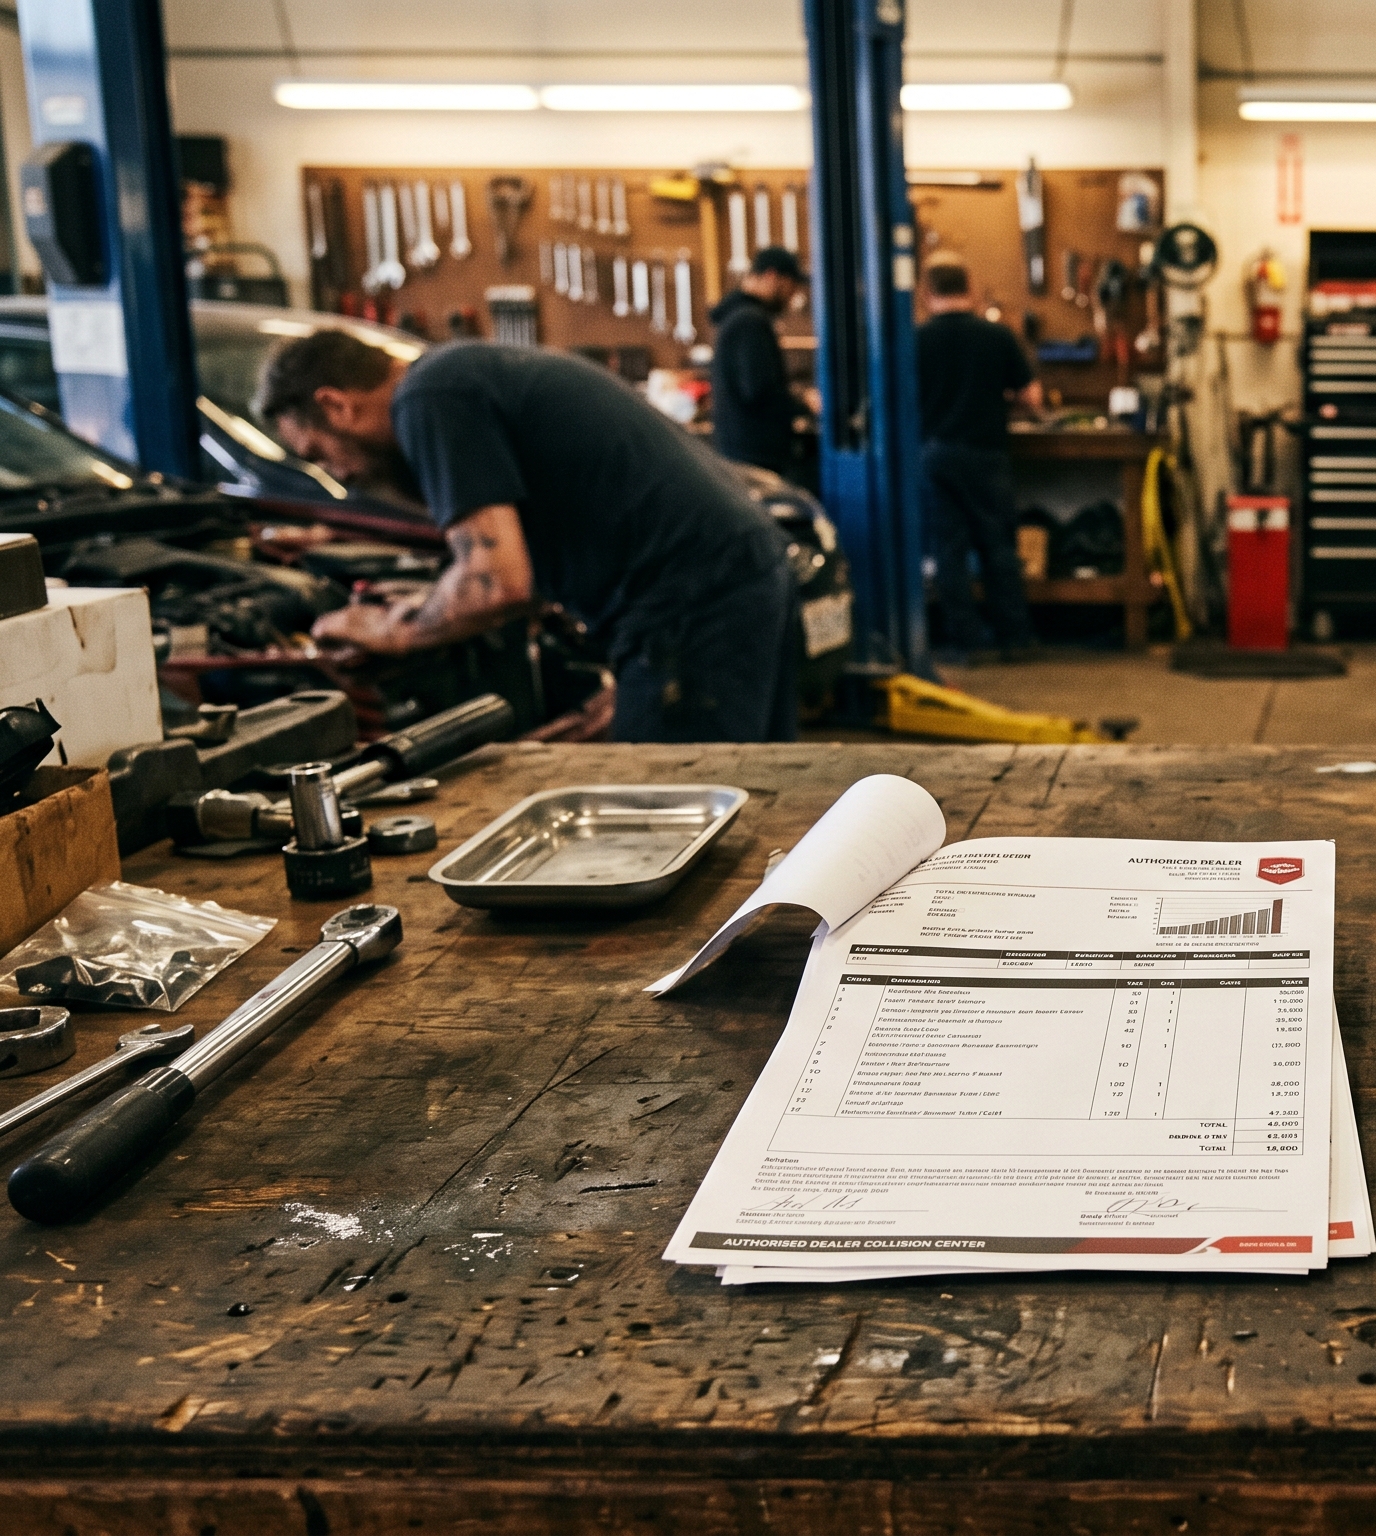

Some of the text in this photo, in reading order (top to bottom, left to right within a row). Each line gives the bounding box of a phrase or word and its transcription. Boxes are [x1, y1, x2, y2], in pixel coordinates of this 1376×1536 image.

[723, 1238, 985, 1248] AUTHORISED DEALER COLLISION CENTER
